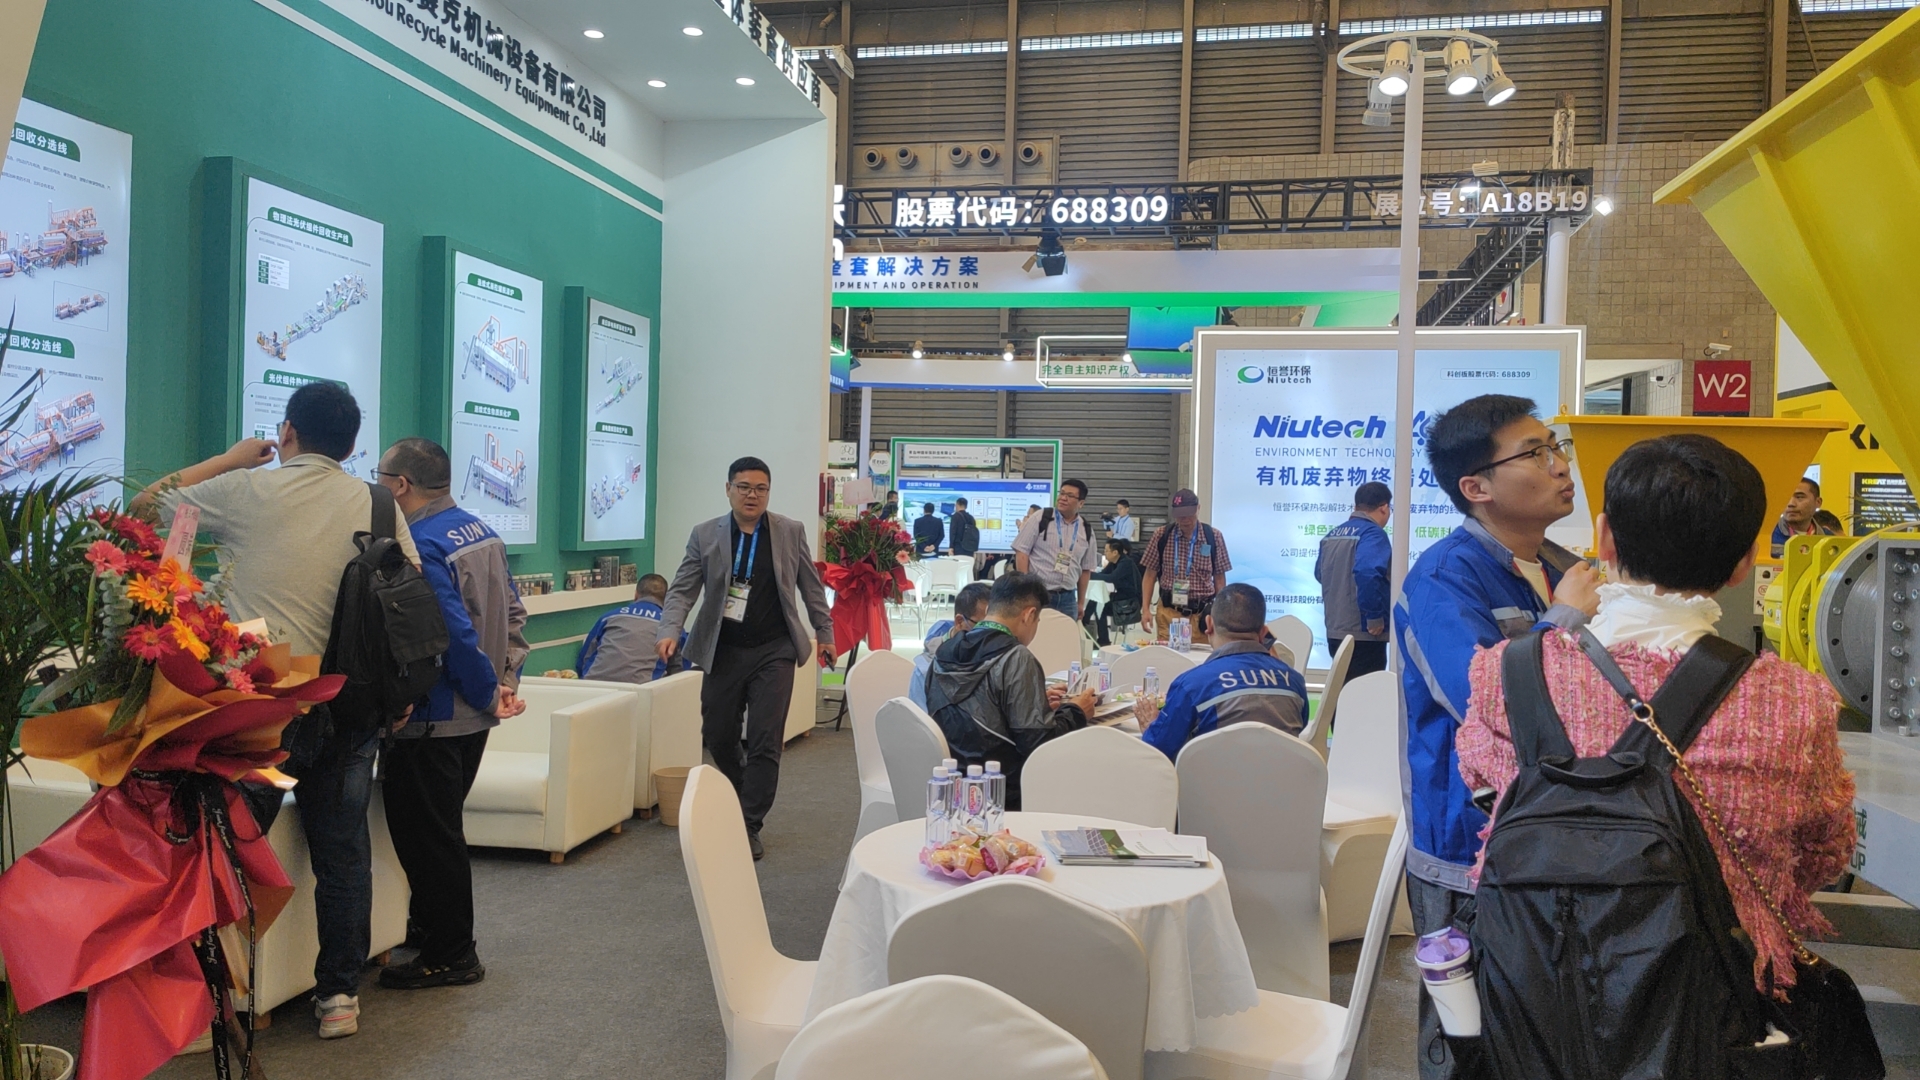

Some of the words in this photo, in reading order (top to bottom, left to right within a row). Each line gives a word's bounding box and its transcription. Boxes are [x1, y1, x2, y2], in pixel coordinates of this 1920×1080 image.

[396, 3, 447, 49] Recycle
[450, 40, 511, 91] Machinery
[515, 78, 570, 126] Equipment
[883, 281, 906, 289] AND
[911, 281, 979, 289] OPERATION
[1042, 364, 1130, 376] 完全自主知识产权
[1267, 366, 1312, 376] 恒誉环保
[1267, 376, 1312, 384] Niutech
[1697, 373, 1747, 399] W2
[1253, 415, 1387, 438] Niutech
[1255, 447, 1338, 457] ENVIRONMENT
[1345, 447, 1422, 458] TECHNOLGY
[447, 520, 491, 546] SUNY
[1330, 526, 1360, 536] SUNY
[619, 606, 662, 618] SUN
[1218, 668, 1292, 689] SUNY
